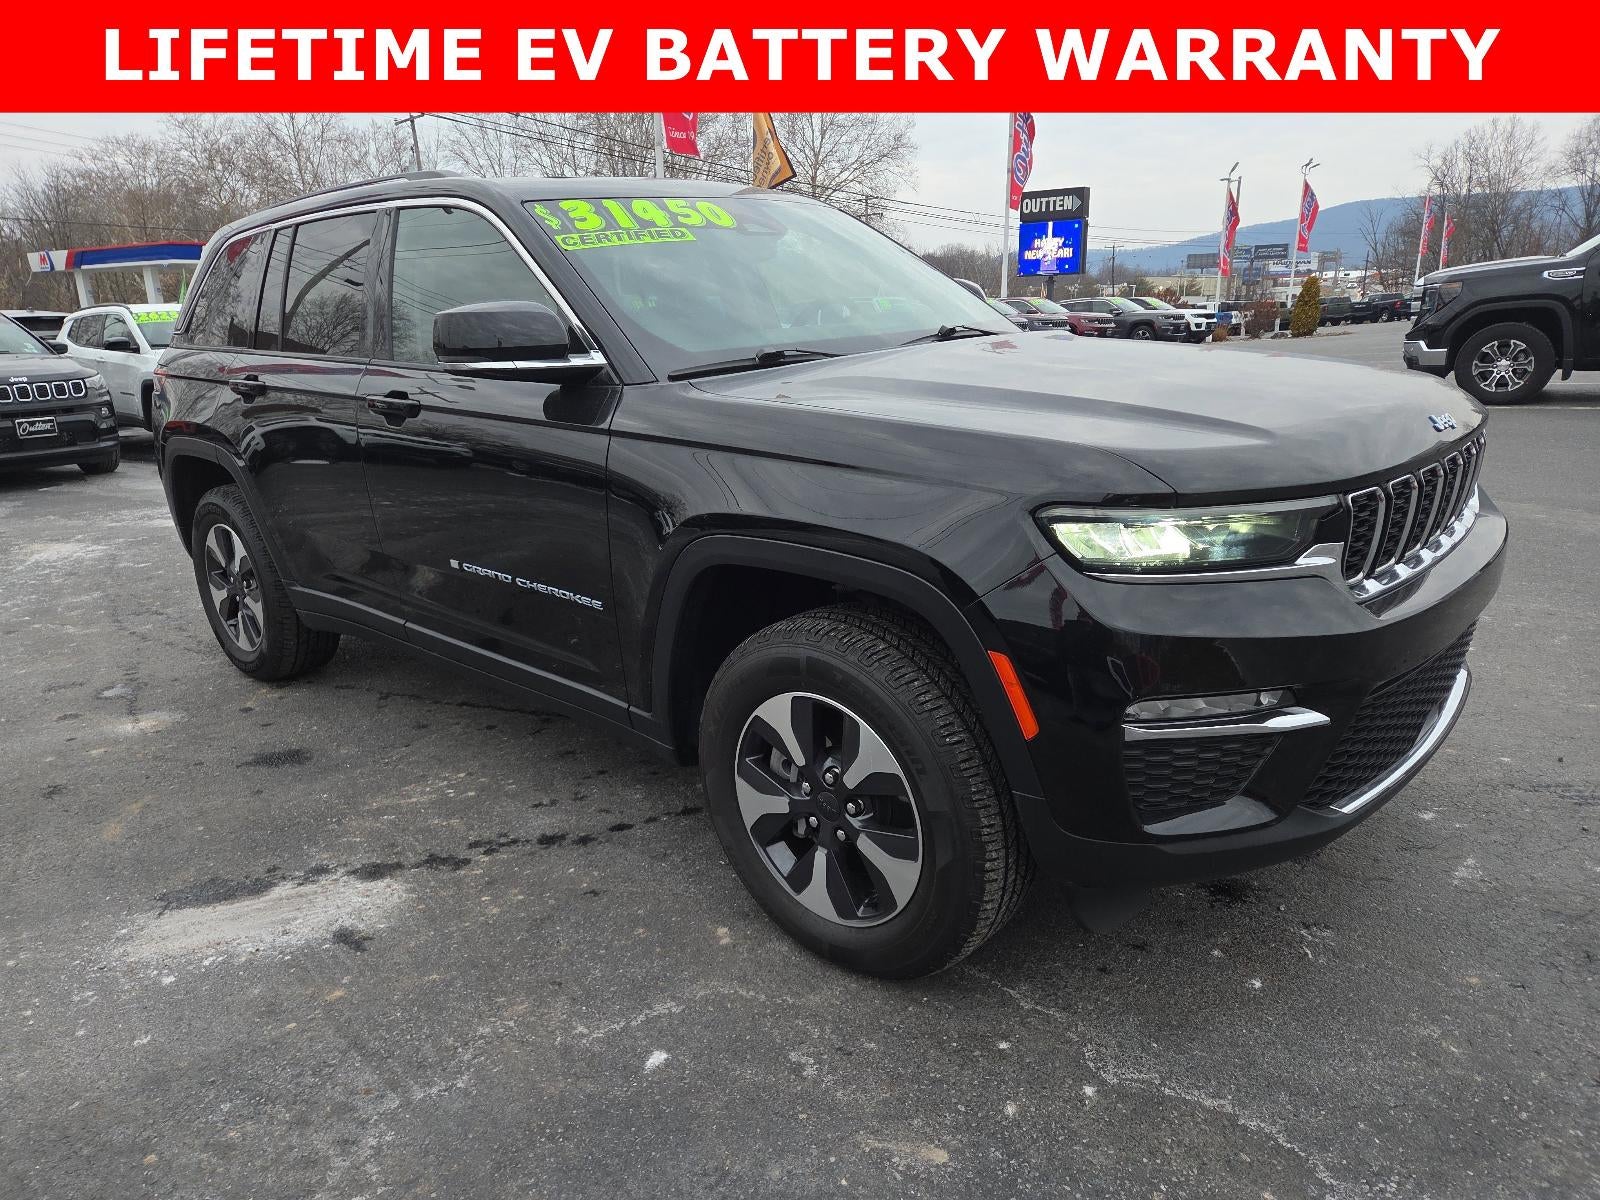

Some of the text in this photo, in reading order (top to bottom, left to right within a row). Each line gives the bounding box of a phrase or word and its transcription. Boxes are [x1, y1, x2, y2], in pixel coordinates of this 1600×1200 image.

[1022, 195, 1073, 214] OUTTEN
[560, 228, 690, 248] CERTIFIED
[20, 421, 55, 435] Outten
[462, 562, 604, 612] GRAND CHEROKEE
